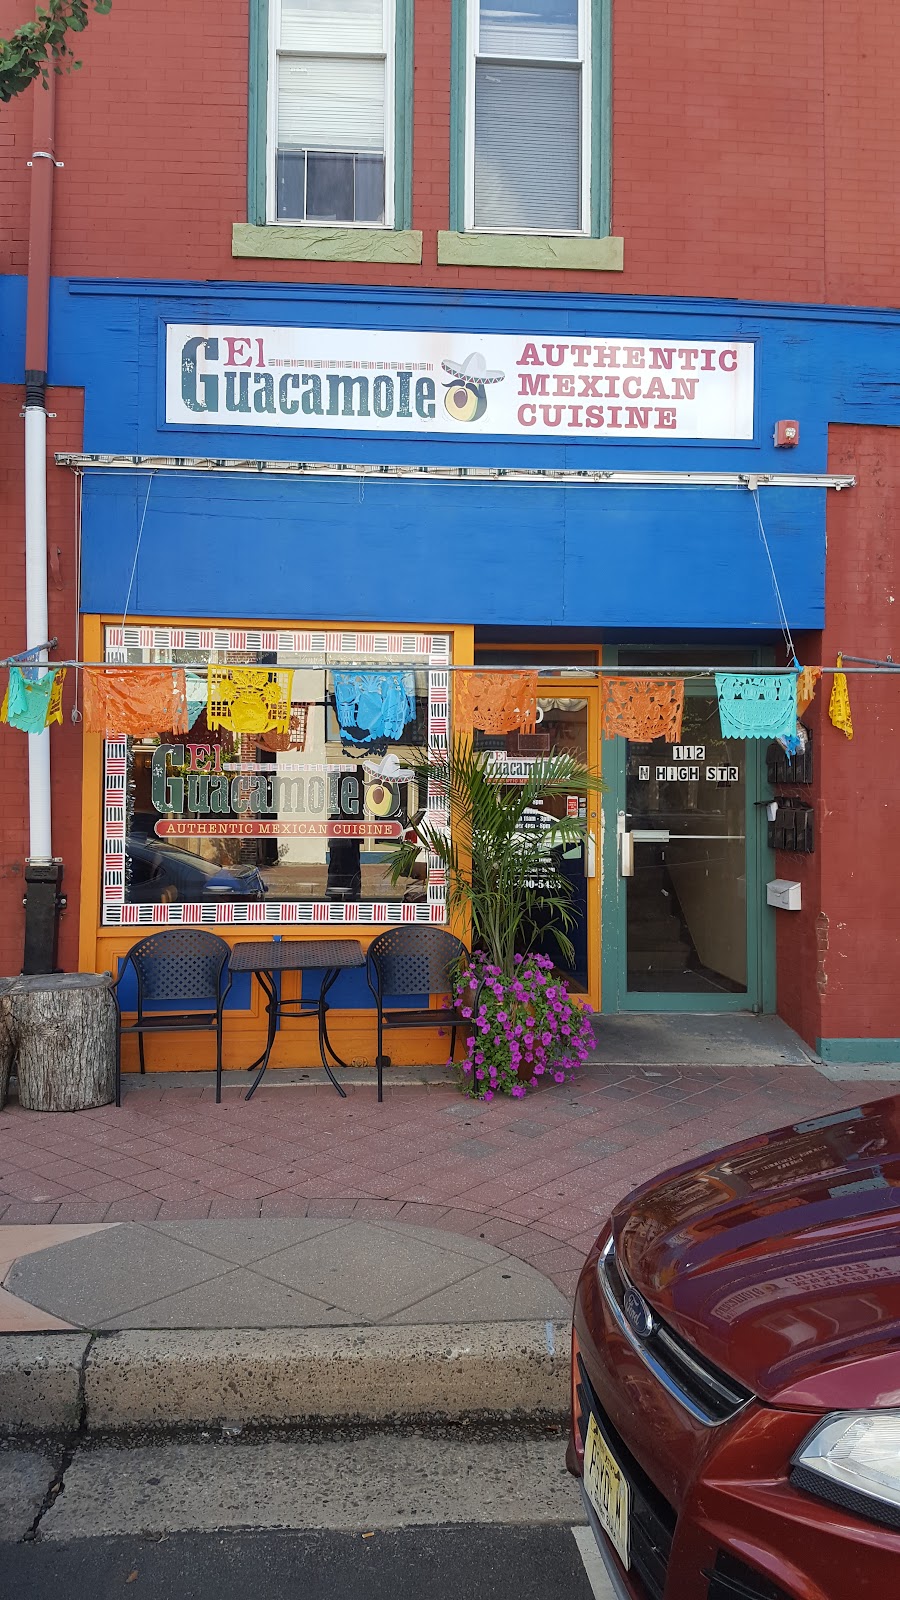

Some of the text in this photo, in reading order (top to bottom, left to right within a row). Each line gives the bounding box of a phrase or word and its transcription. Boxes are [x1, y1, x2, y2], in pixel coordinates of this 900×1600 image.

[223, 337, 266, 367] El
[516, 343, 738, 372] AUTHENTIC
[181, 336, 436, 419] Guacamole
[517, 373, 700, 400] MEXICAN
[517, 403, 677, 430] CUISINE
[186, 744, 222, 771] El
[675, 747, 704, 759] 112
[152, 744, 359, 814] Guacamole
[640, 767, 737, 780] N HIGH STR
[166, 823, 393, 835] AUTHENTIC MEXICAN CUISINE
[624, 1294, 642, 1326] Ford
